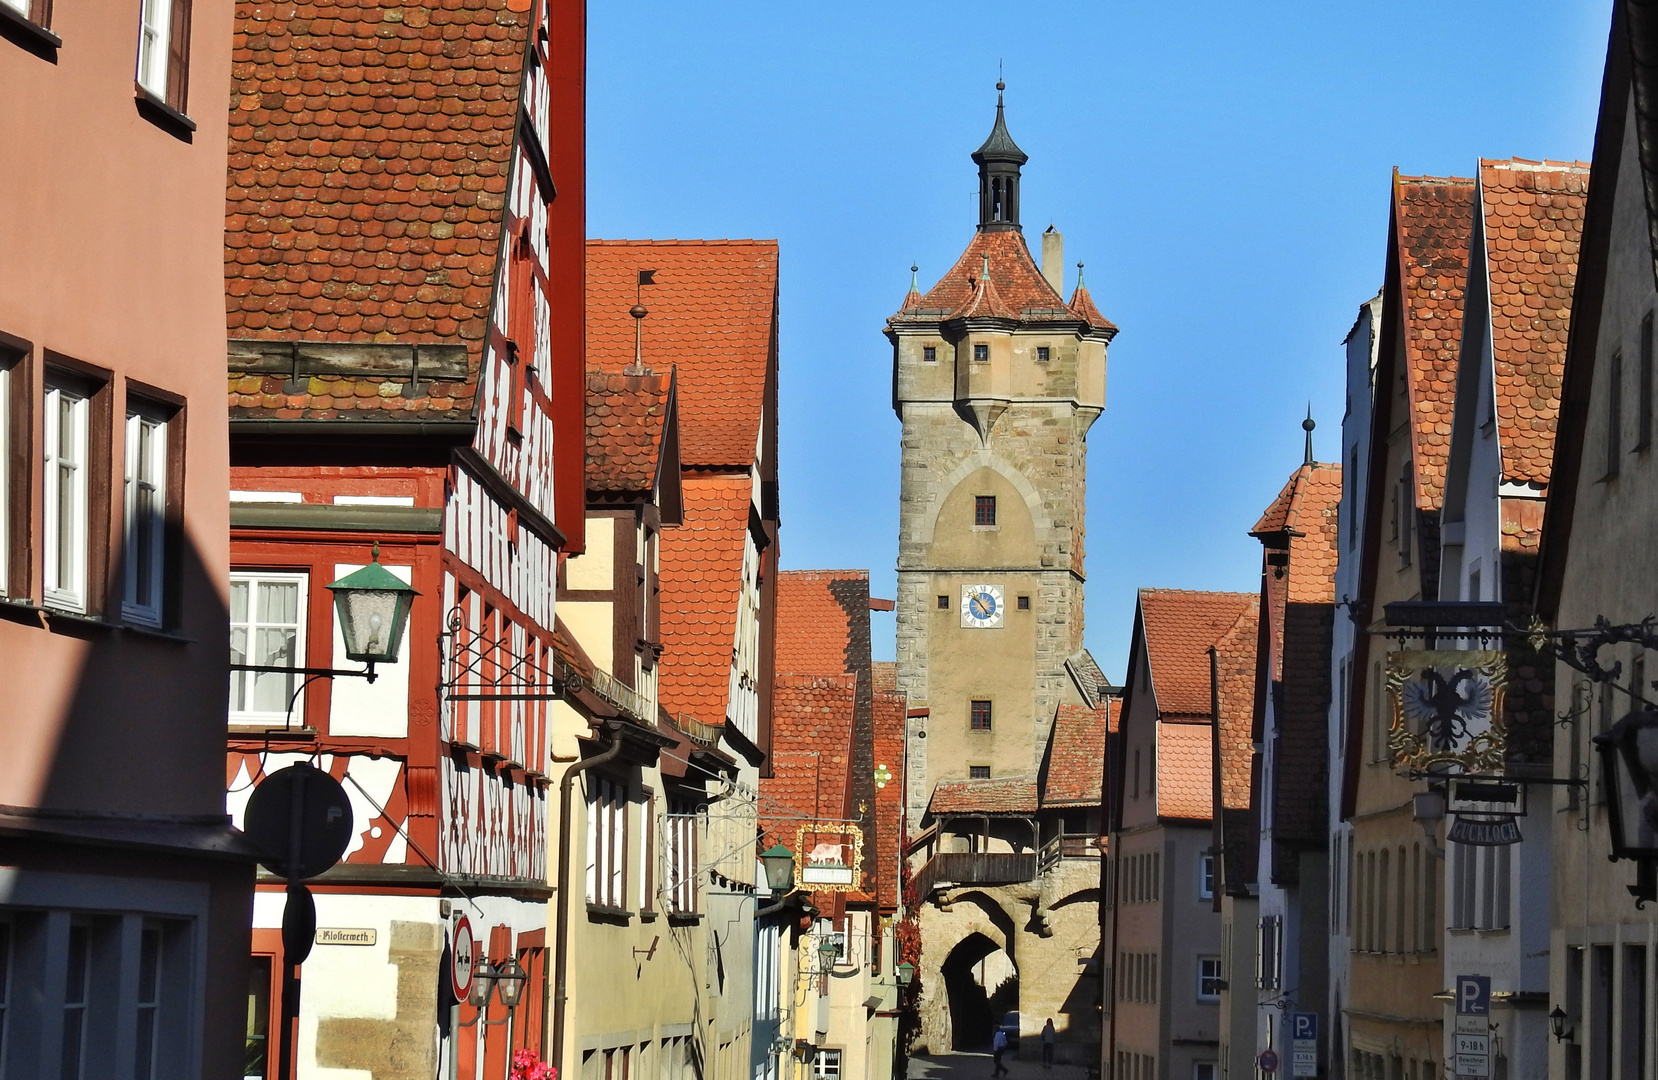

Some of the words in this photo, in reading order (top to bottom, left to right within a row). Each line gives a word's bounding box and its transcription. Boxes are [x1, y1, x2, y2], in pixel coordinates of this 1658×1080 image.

[1452, 821, 1518, 843] GUCKLOCH
[1462, 980, 1480, 1012] P
[1296, 1016, 1310, 1036] P
[1458, 1025, 1487, 1033] Parkschein
[1461, 1040, 1478, 1051] 9-18
